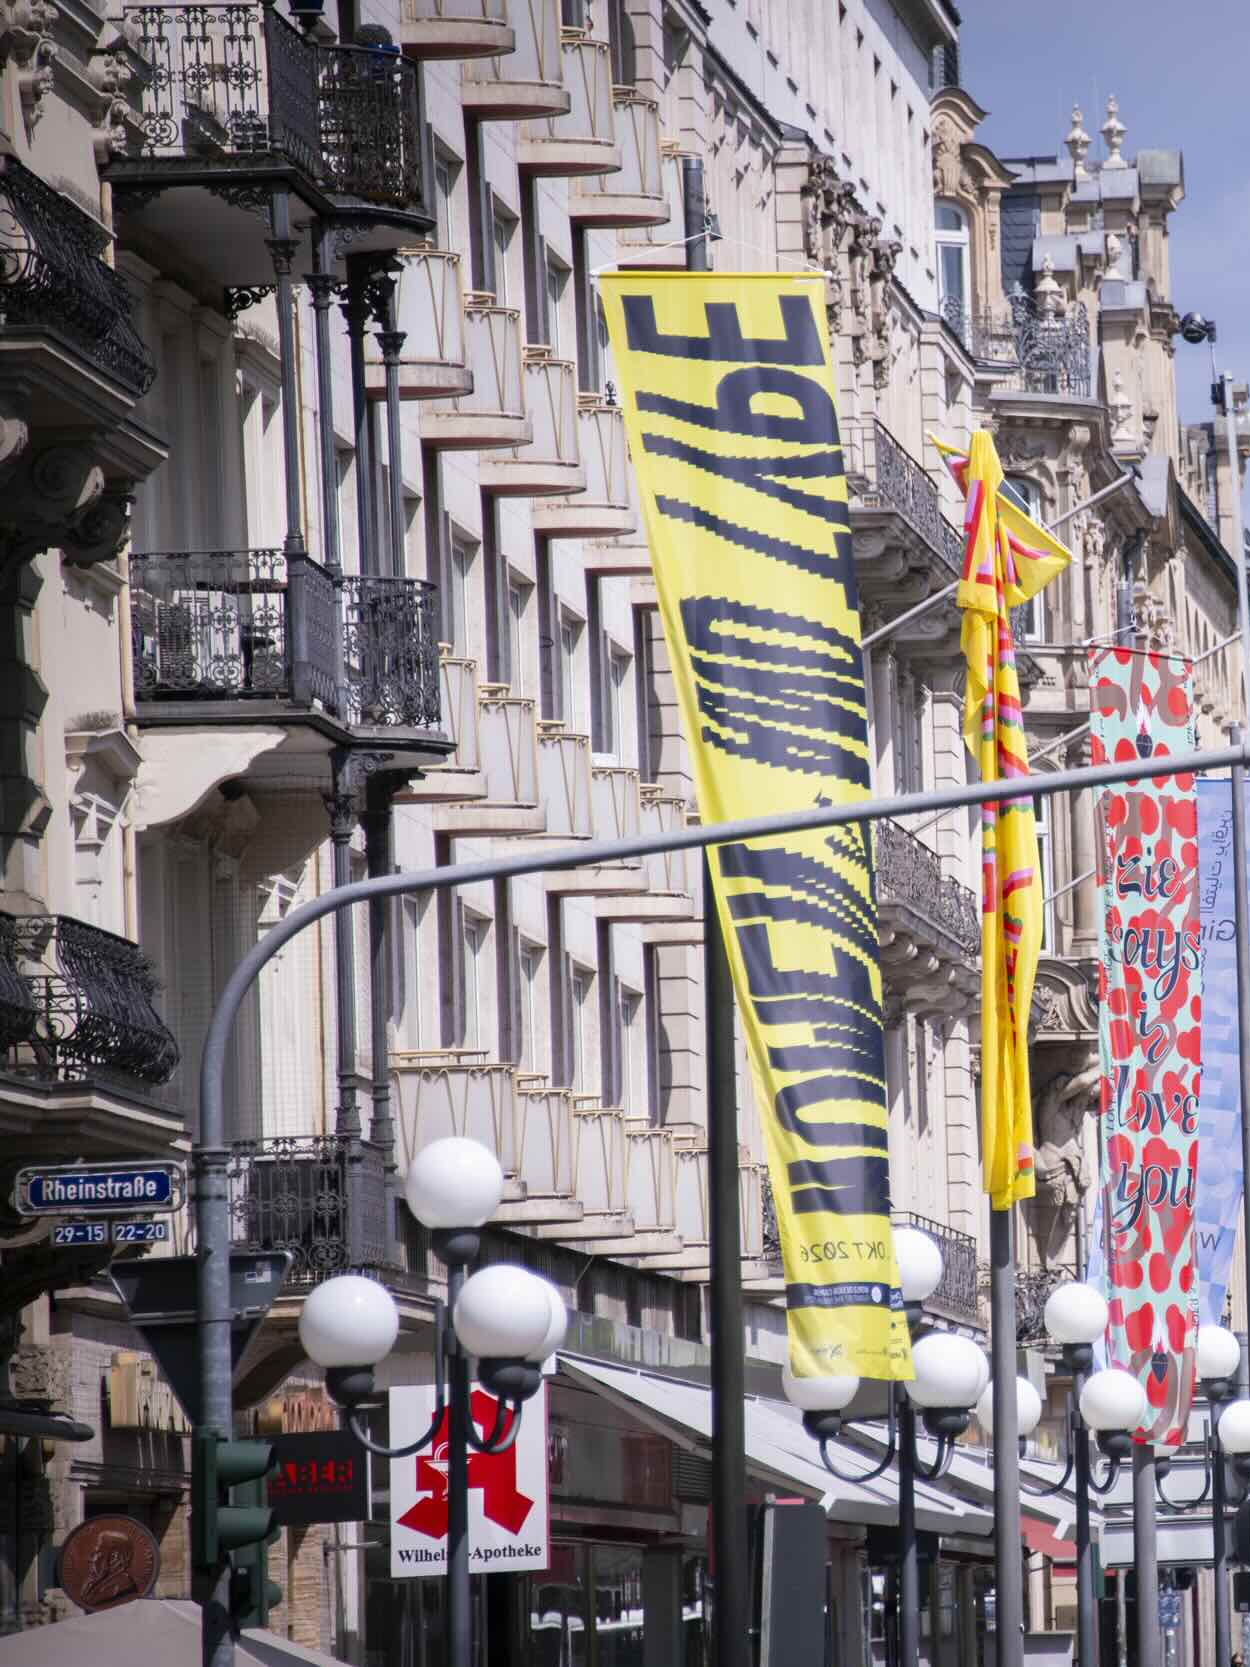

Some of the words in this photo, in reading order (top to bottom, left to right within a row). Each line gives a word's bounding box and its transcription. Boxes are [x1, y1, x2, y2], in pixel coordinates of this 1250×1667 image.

[42, 1176, 157, 1201] Rheinstraße
[1112, 1163, 1193, 1233] you
[55, 1225, 104, 1243] 29-15
[116, 1224, 165, 1241] 22-20
[398, 1543, 542, 1563] Wilhel-Apotheke
